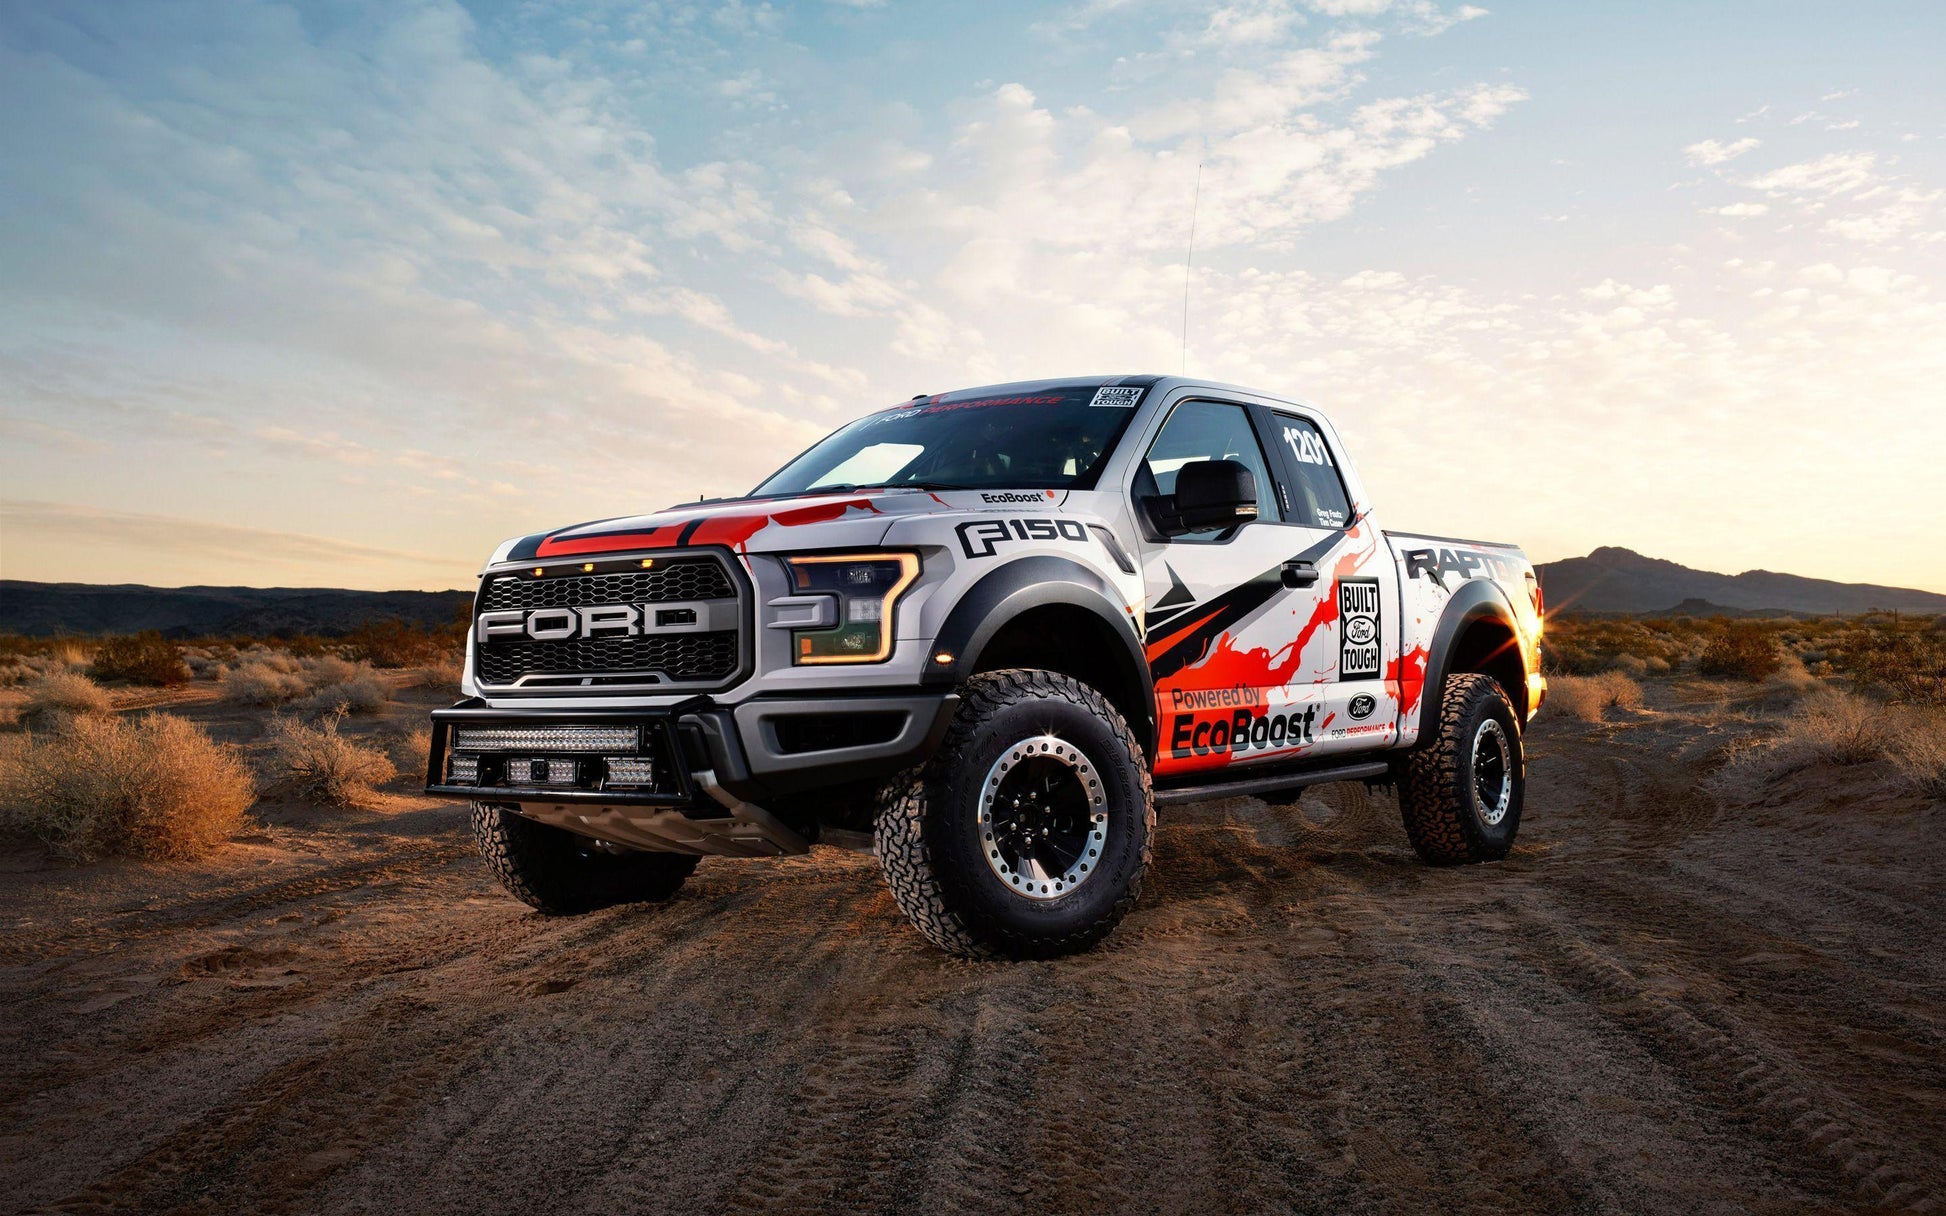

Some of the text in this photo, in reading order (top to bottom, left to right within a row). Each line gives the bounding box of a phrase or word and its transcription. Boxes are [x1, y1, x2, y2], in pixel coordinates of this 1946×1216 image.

[874, 396, 1066, 424] FORD PERFORMANCE
[1283, 426, 1334, 467] 1201
[980, 492, 1045, 504] EcoBoost
[1343, 586, 1376, 613] BUILT
[477, 600, 711, 643] FORD
[1351, 620, 1371, 639] Ford
[1344, 648, 1377, 671] TOUGH
[1172, 683, 1260, 710] Powered by
[1352, 698, 1371, 715] Ford
[1171, 704, 1315, 759] EcoBoost
